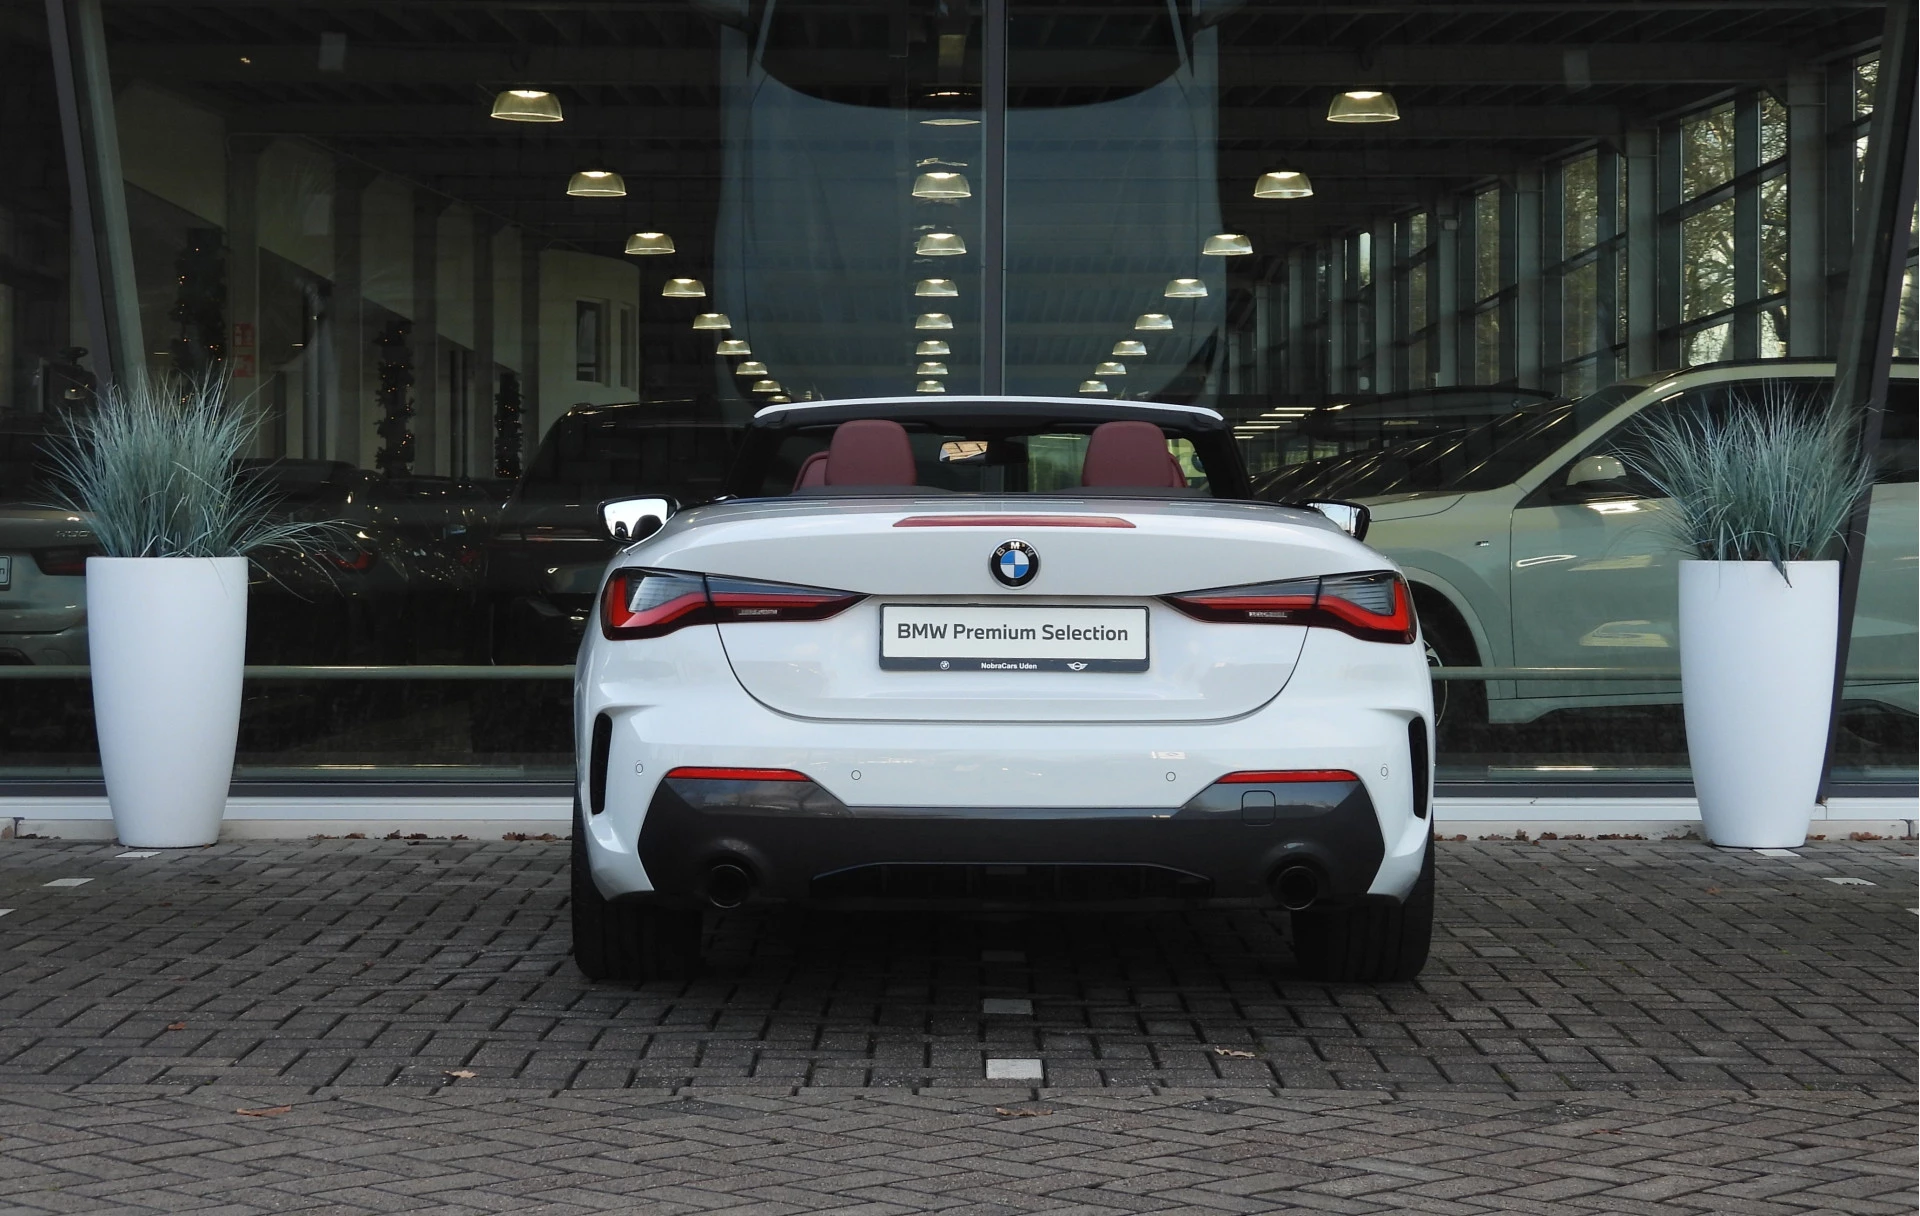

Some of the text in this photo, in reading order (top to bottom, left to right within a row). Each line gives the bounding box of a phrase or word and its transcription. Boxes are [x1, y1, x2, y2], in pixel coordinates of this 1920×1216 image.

[996, 542, 1035, 557] BMW
[897, 623, 1129, 641] BMW Premium Selection
[981, 661, 1038, 670] NobraCars Uden
